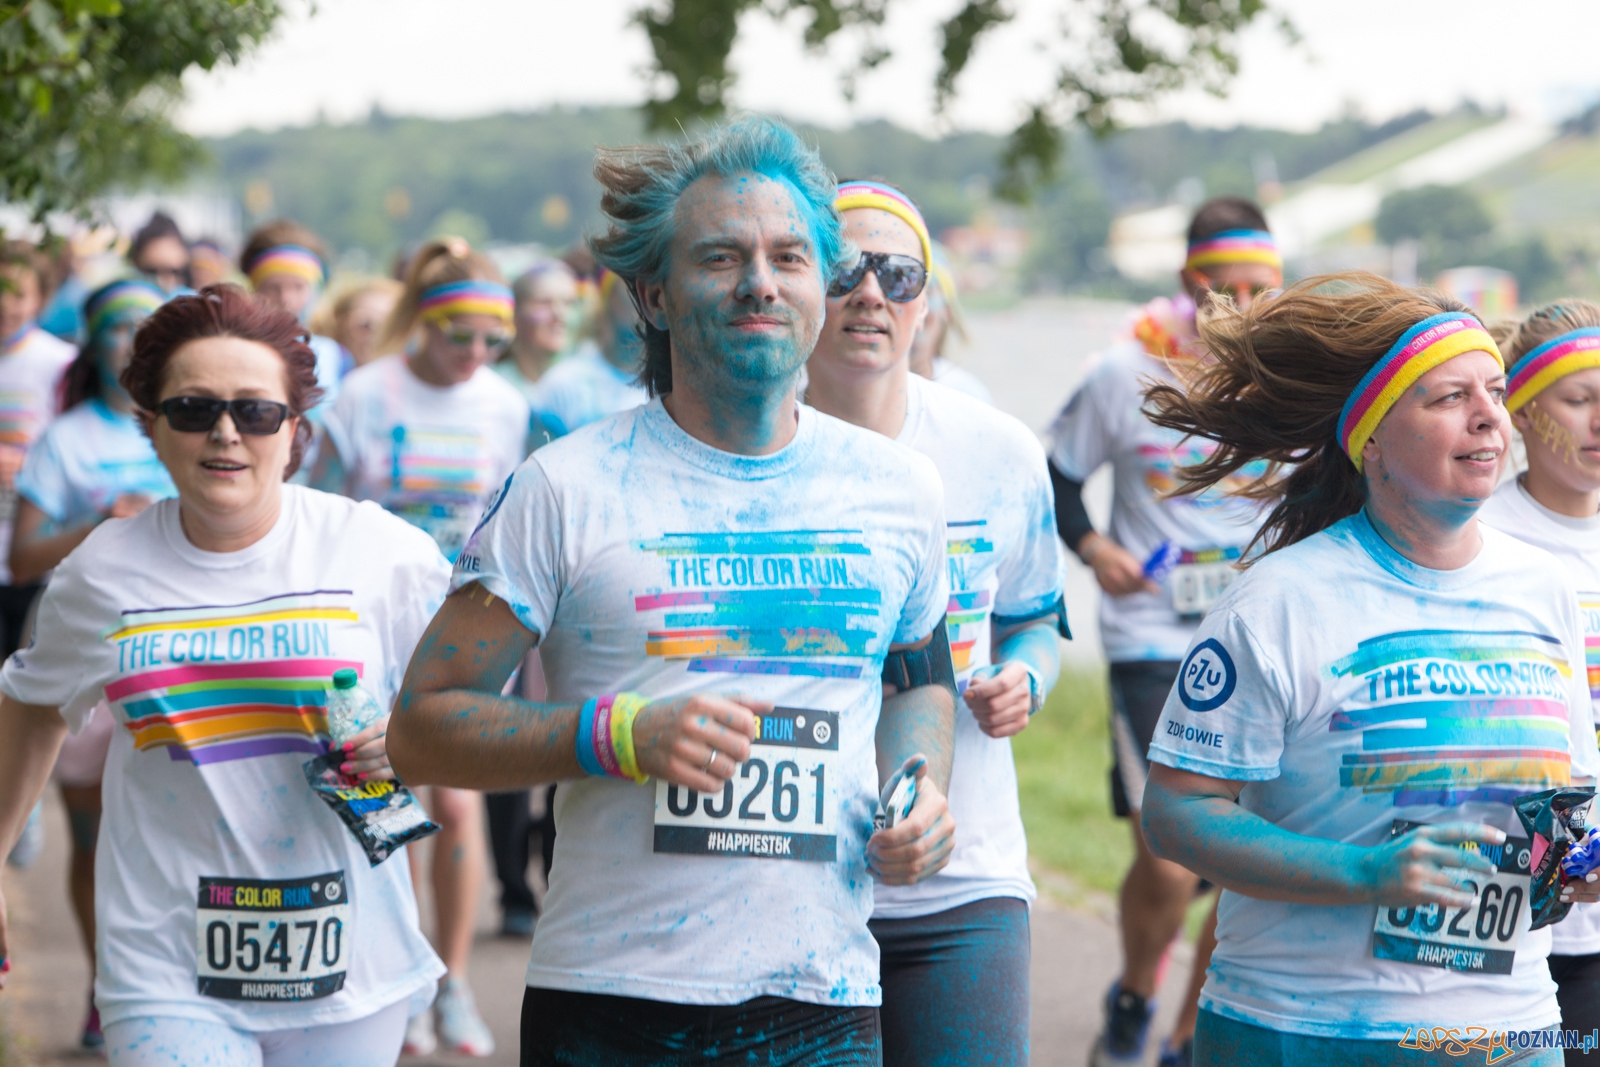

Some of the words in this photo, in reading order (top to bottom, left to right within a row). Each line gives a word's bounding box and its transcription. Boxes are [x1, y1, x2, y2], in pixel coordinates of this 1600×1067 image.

[1411, 329, 1437, 350] COLOR
[666, 558, 712, 587] THE
[716, 557, 796, 586] COLOR
[117, 633, 164, 673] THE
[168, 626, 265, 663] COLOR
[1187, 658, 1221, 691] PZU
[1364, 663, 1422, 702] THE
[1425, 661, 1521, 696] COLOR
[707, 832, 791, 855] #HAPPIEST5K
[209, 885, 234, 905] THE
[235, 886, 282, 907] COLOR
[206, 916, 342, 973] 05470
[241, 981, 315, 999] #HAPPIEST5K
